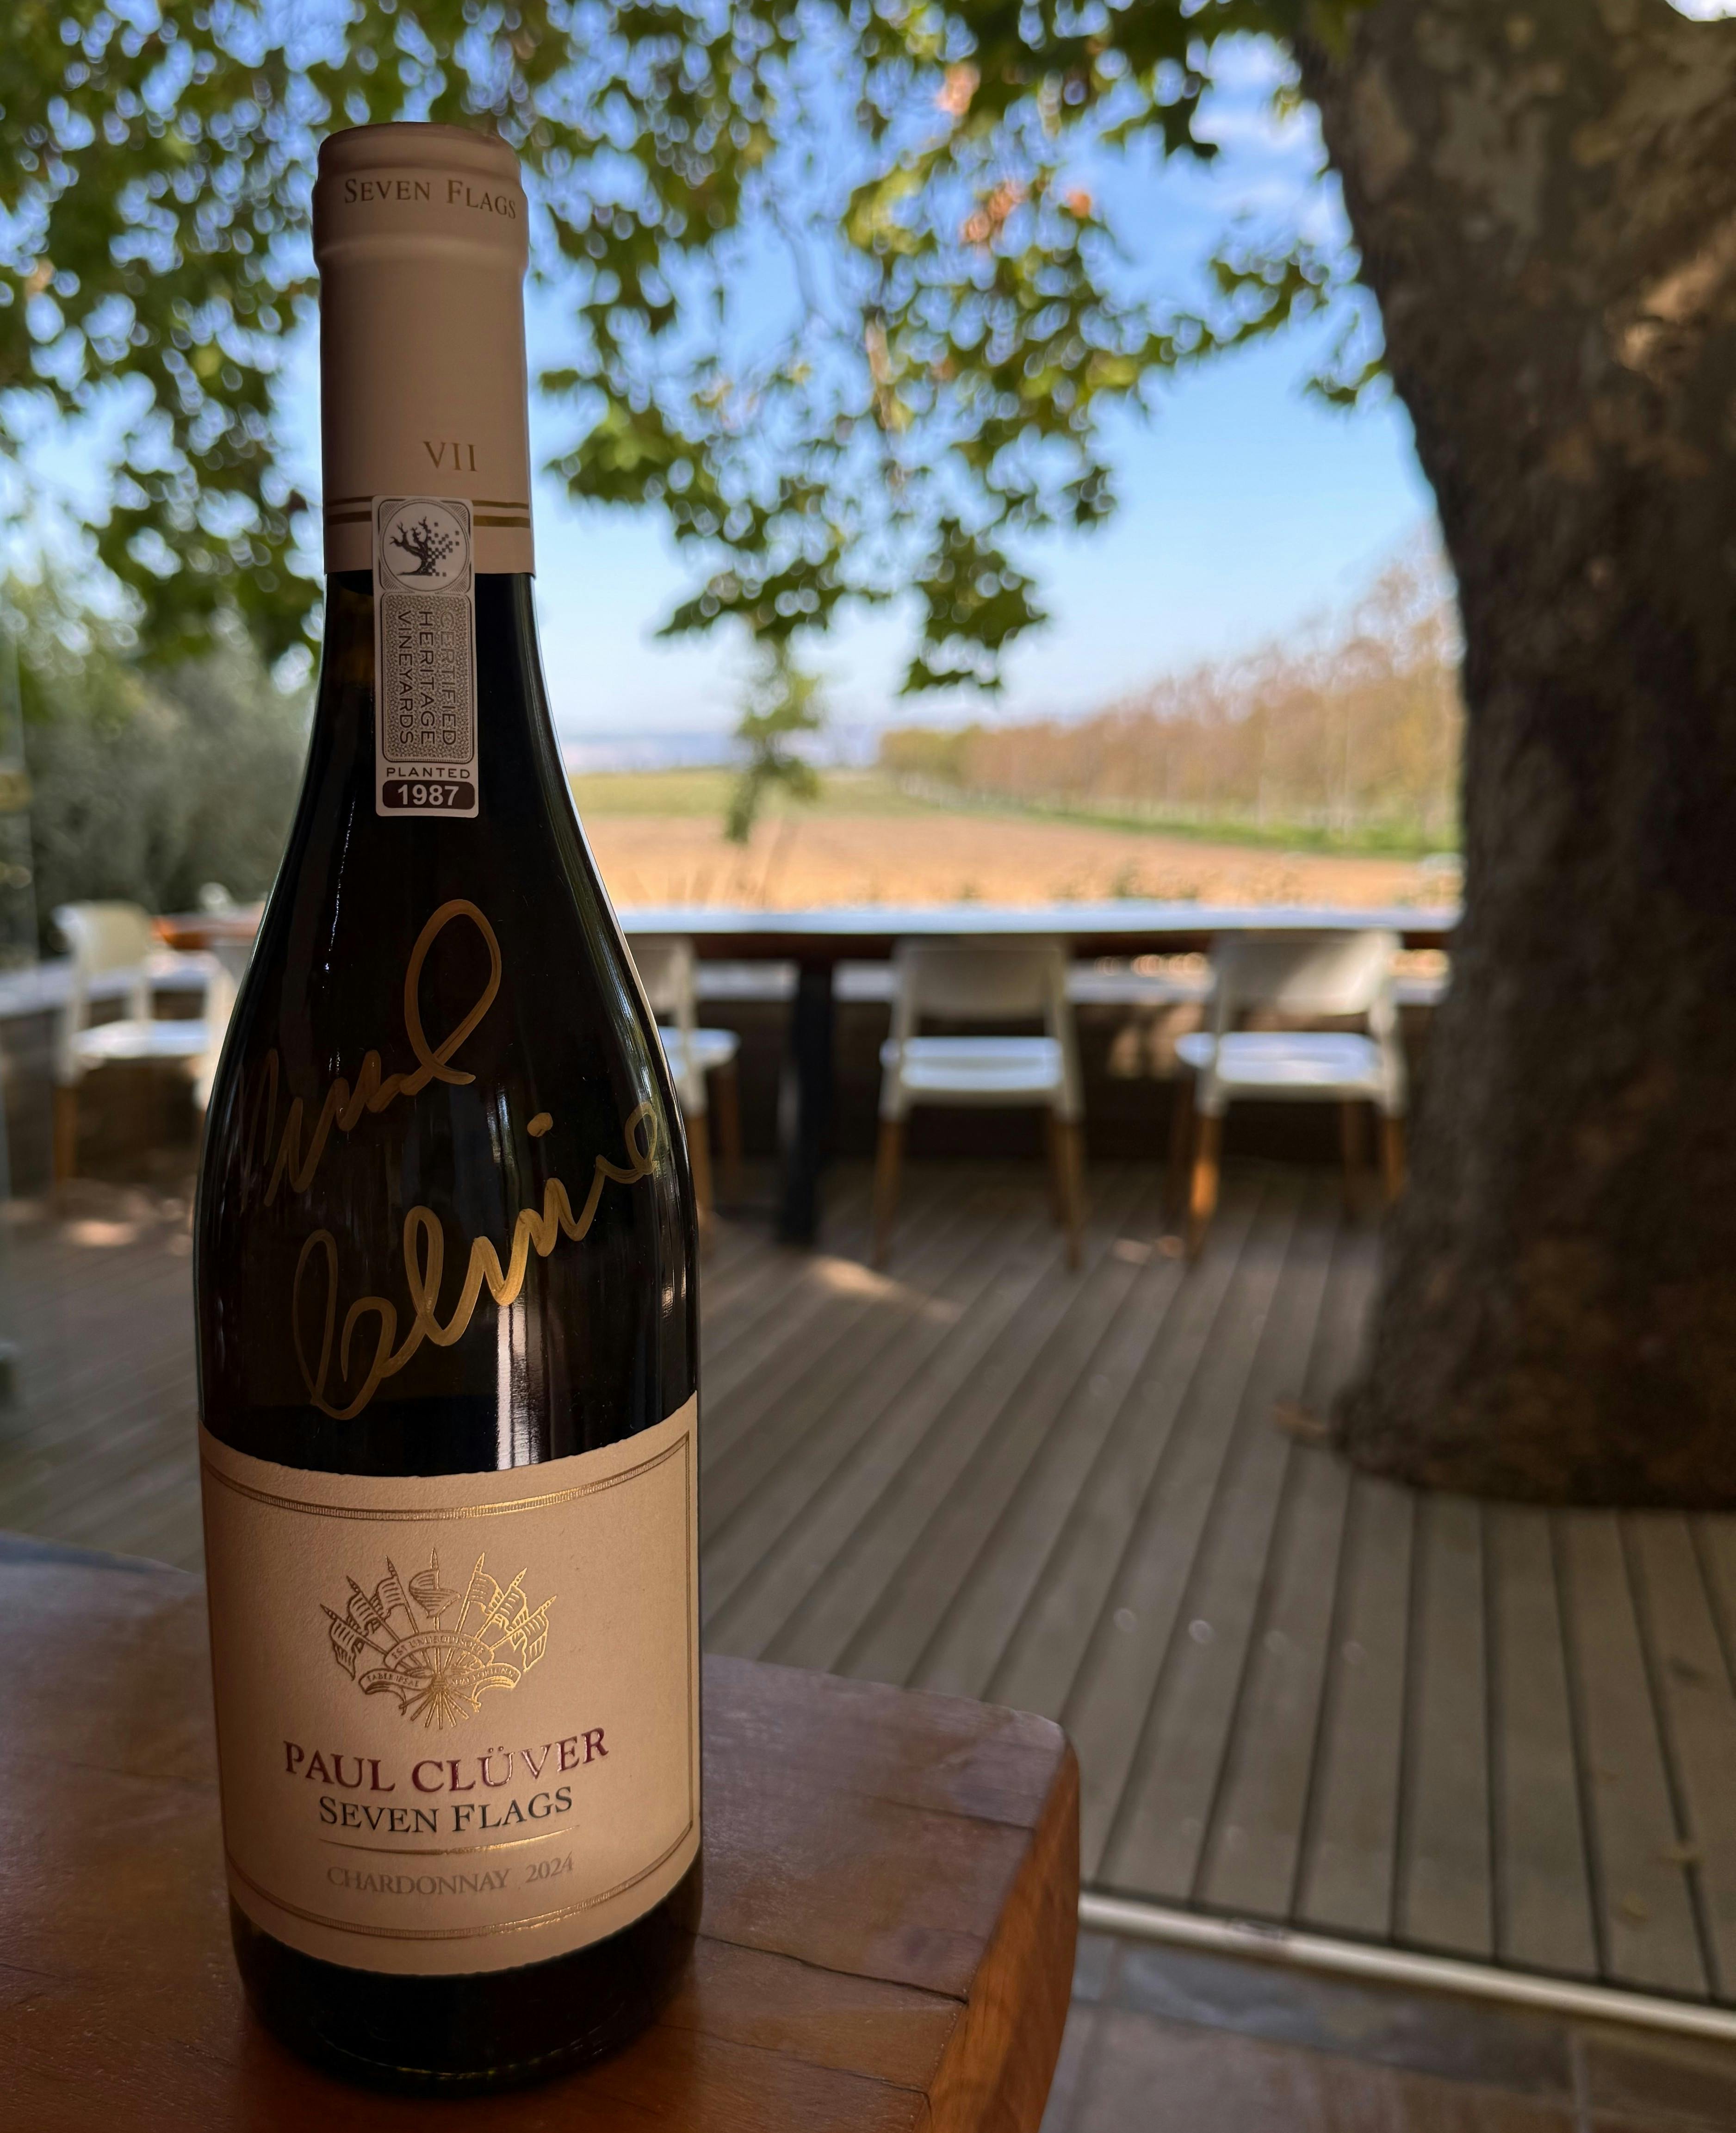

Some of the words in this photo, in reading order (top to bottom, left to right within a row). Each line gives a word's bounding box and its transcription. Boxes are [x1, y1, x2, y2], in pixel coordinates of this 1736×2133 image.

[344, 178, 431, 204] SEVEN
[446, 179, 516, 219] FLAGS
[423, 441, 478, 472] VII
[398, 610, 414, 744] VINEYARDS
[419, 611, 435, 744] HERITAGE
[440, 610, 457, 745] CERTIFIED
[386, 767, 471, 779] PLANTED
[397, 784, 459, 806] 1987
[283, 1740, 396, 1792] PAUL
[412, 1727, 609, 1792] CLÜVER
[319, 1796, 440, 1834] SEVEN
[451, 1786, 573, 1832] FLAGS
[327, 1866, 511, 1896] CHARDONNAY
[525, 1851, 574, 1884] 2024
